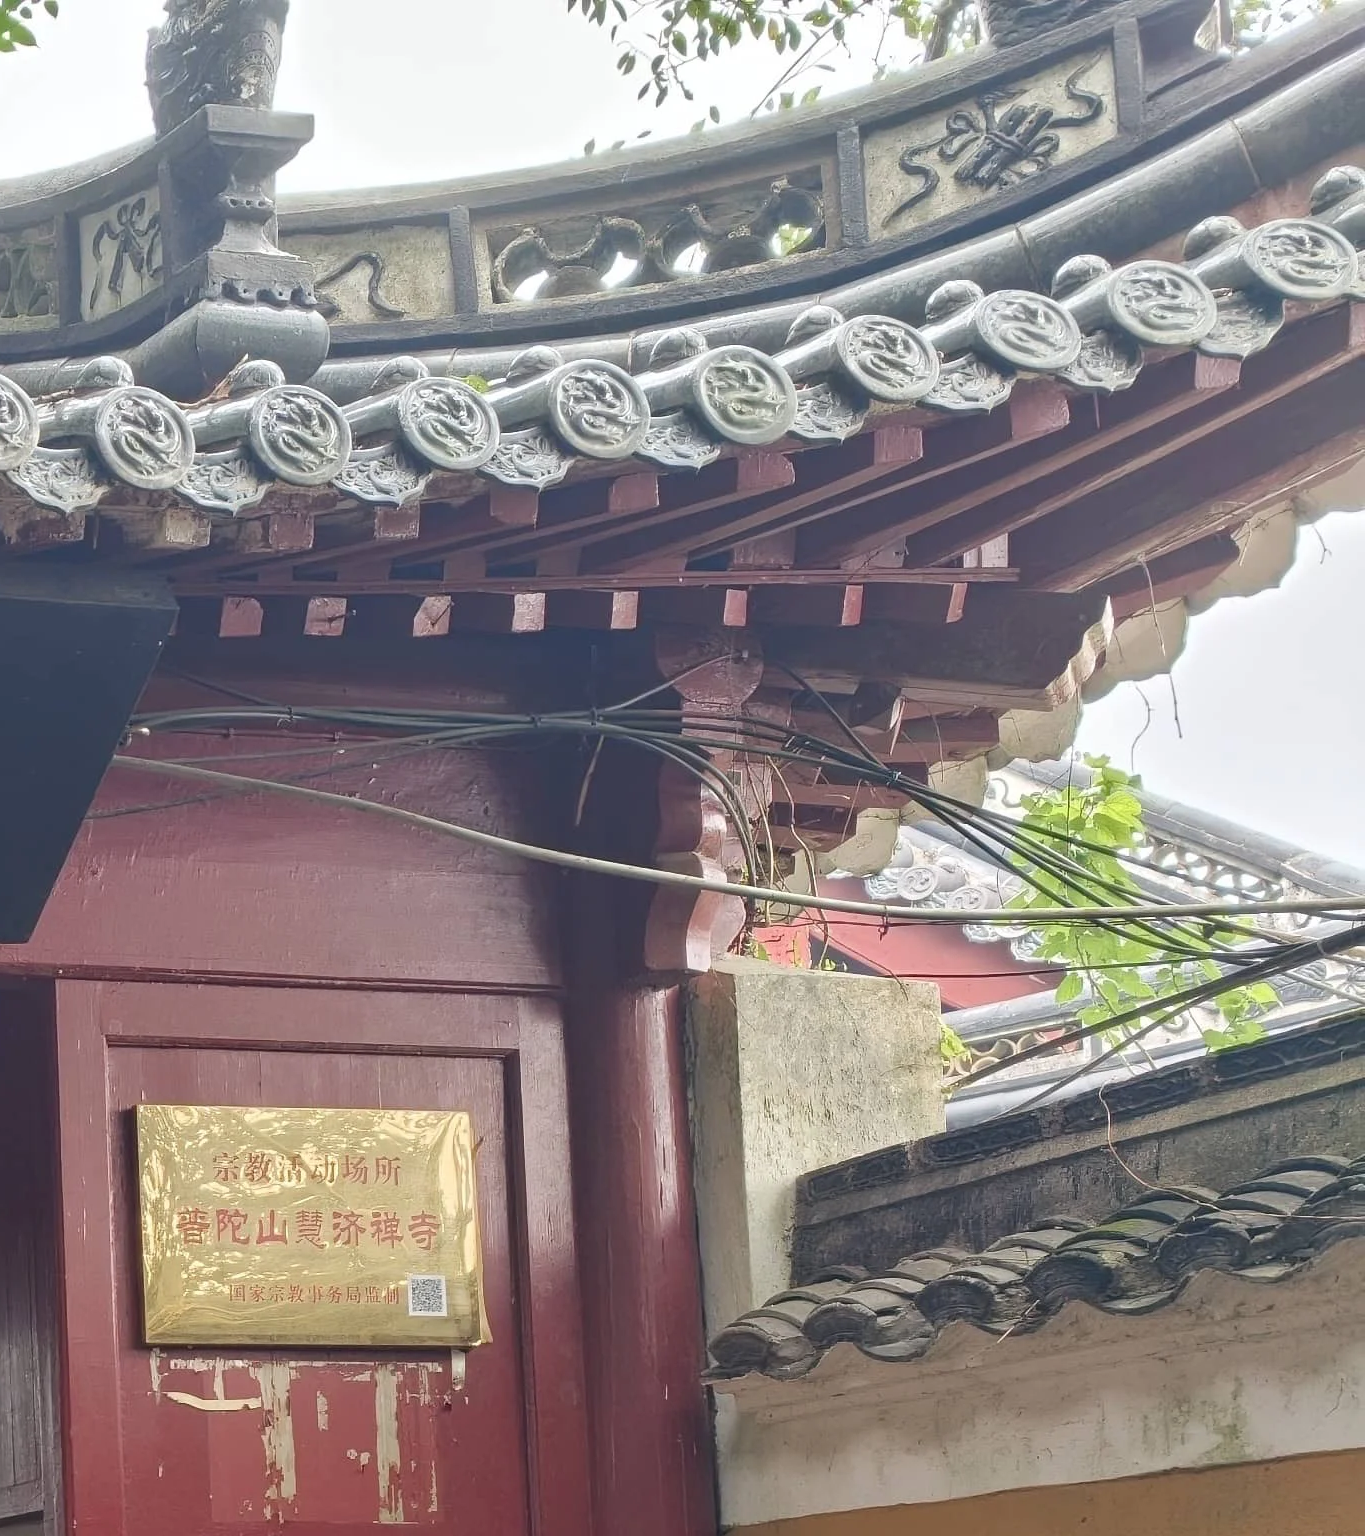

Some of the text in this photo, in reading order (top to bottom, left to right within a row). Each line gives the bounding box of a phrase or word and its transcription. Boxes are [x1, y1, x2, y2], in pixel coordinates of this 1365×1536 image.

[212, 1152, 401, 1186] 宗教活动场所
[176, 1208, 441, 1250] 普陀山慧济禅寺
[229, 1284, 400, 1306] 国家宗教事务局监制
